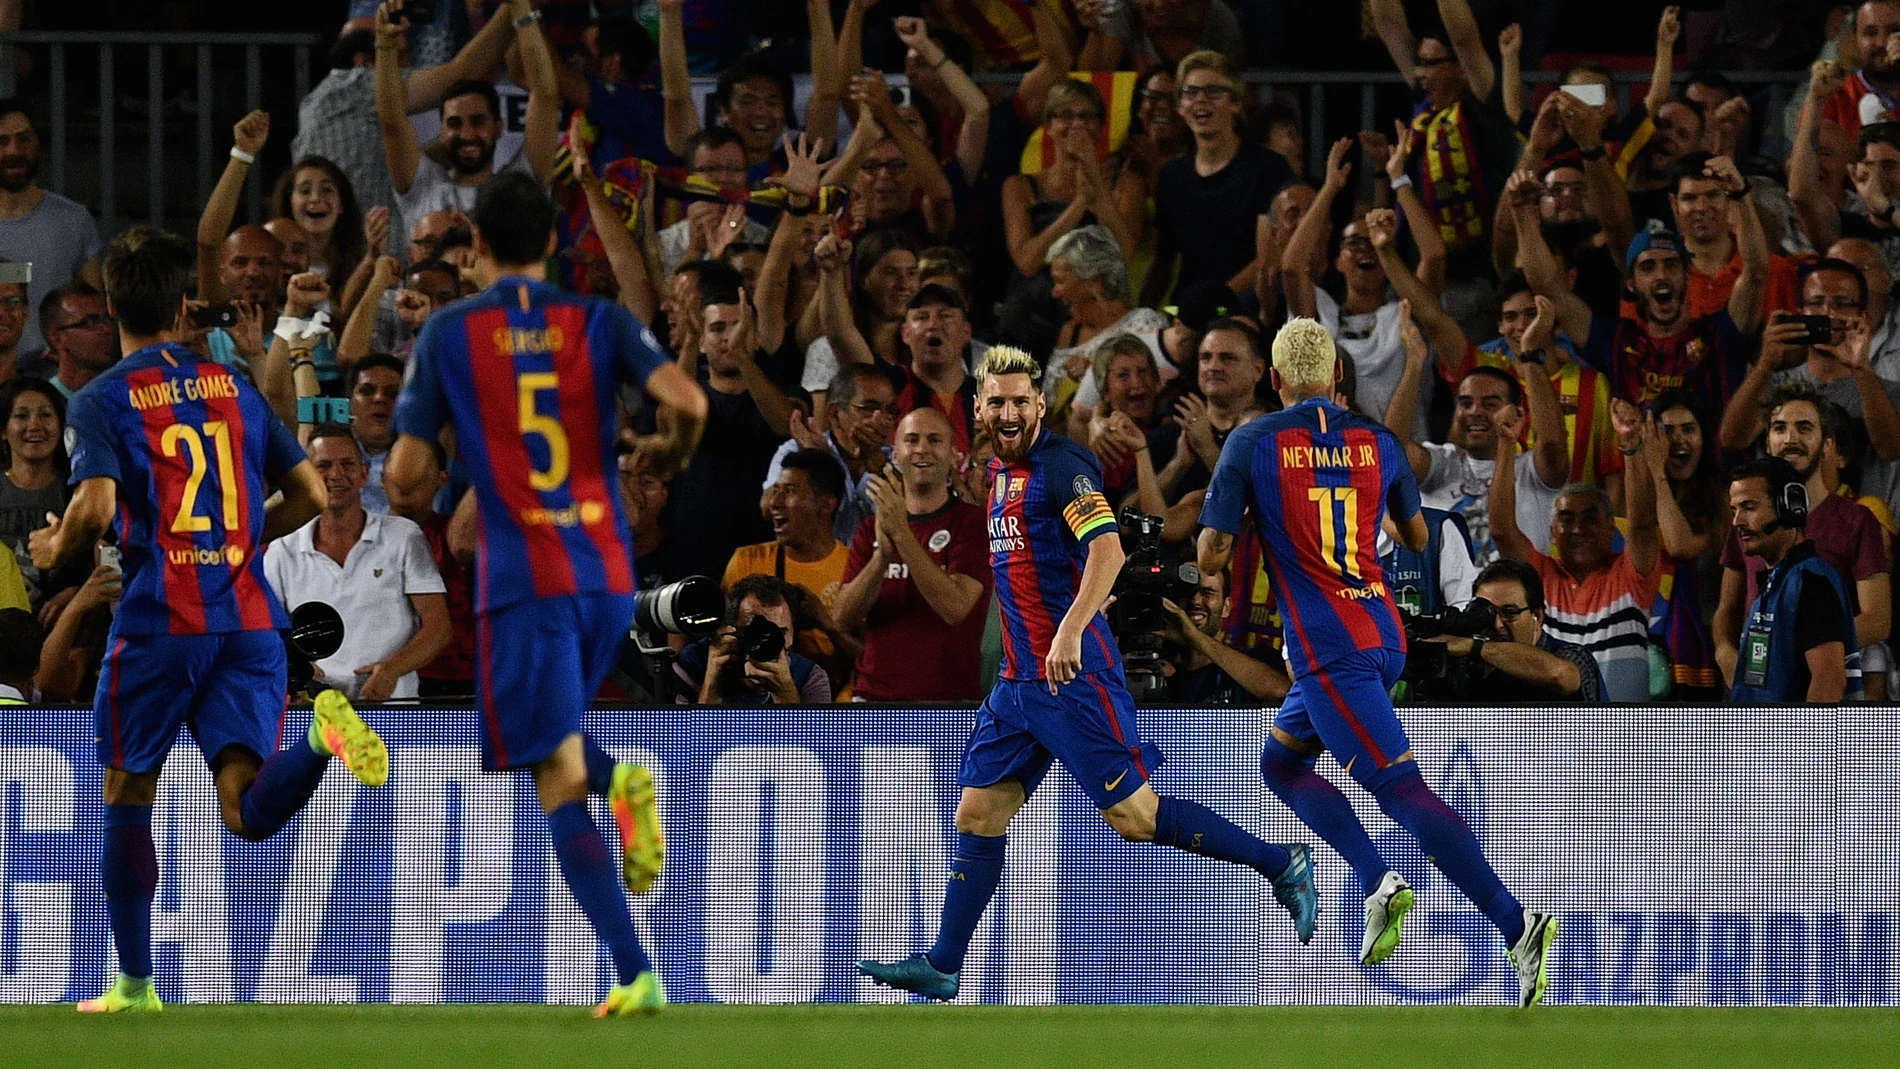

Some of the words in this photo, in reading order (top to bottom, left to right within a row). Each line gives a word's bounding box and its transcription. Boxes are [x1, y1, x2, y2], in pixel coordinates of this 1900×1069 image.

[129, 377, 183, 411] ANDRÉ
[184, 374, 239, 401] GOMES
[518, 371, 570, 492] 5
[1282, 446, 1354, 469] NEYMAR
[1358, 444, 1376, 468] JR
[161, 420, 239, 533] 21
[169, 545, 228, 566] unicef
[987, 516, 1022, 539] ATAR
[1307, 486, 1363, 580] 11
[1505, 911, 1892, 1004] AZPROM
